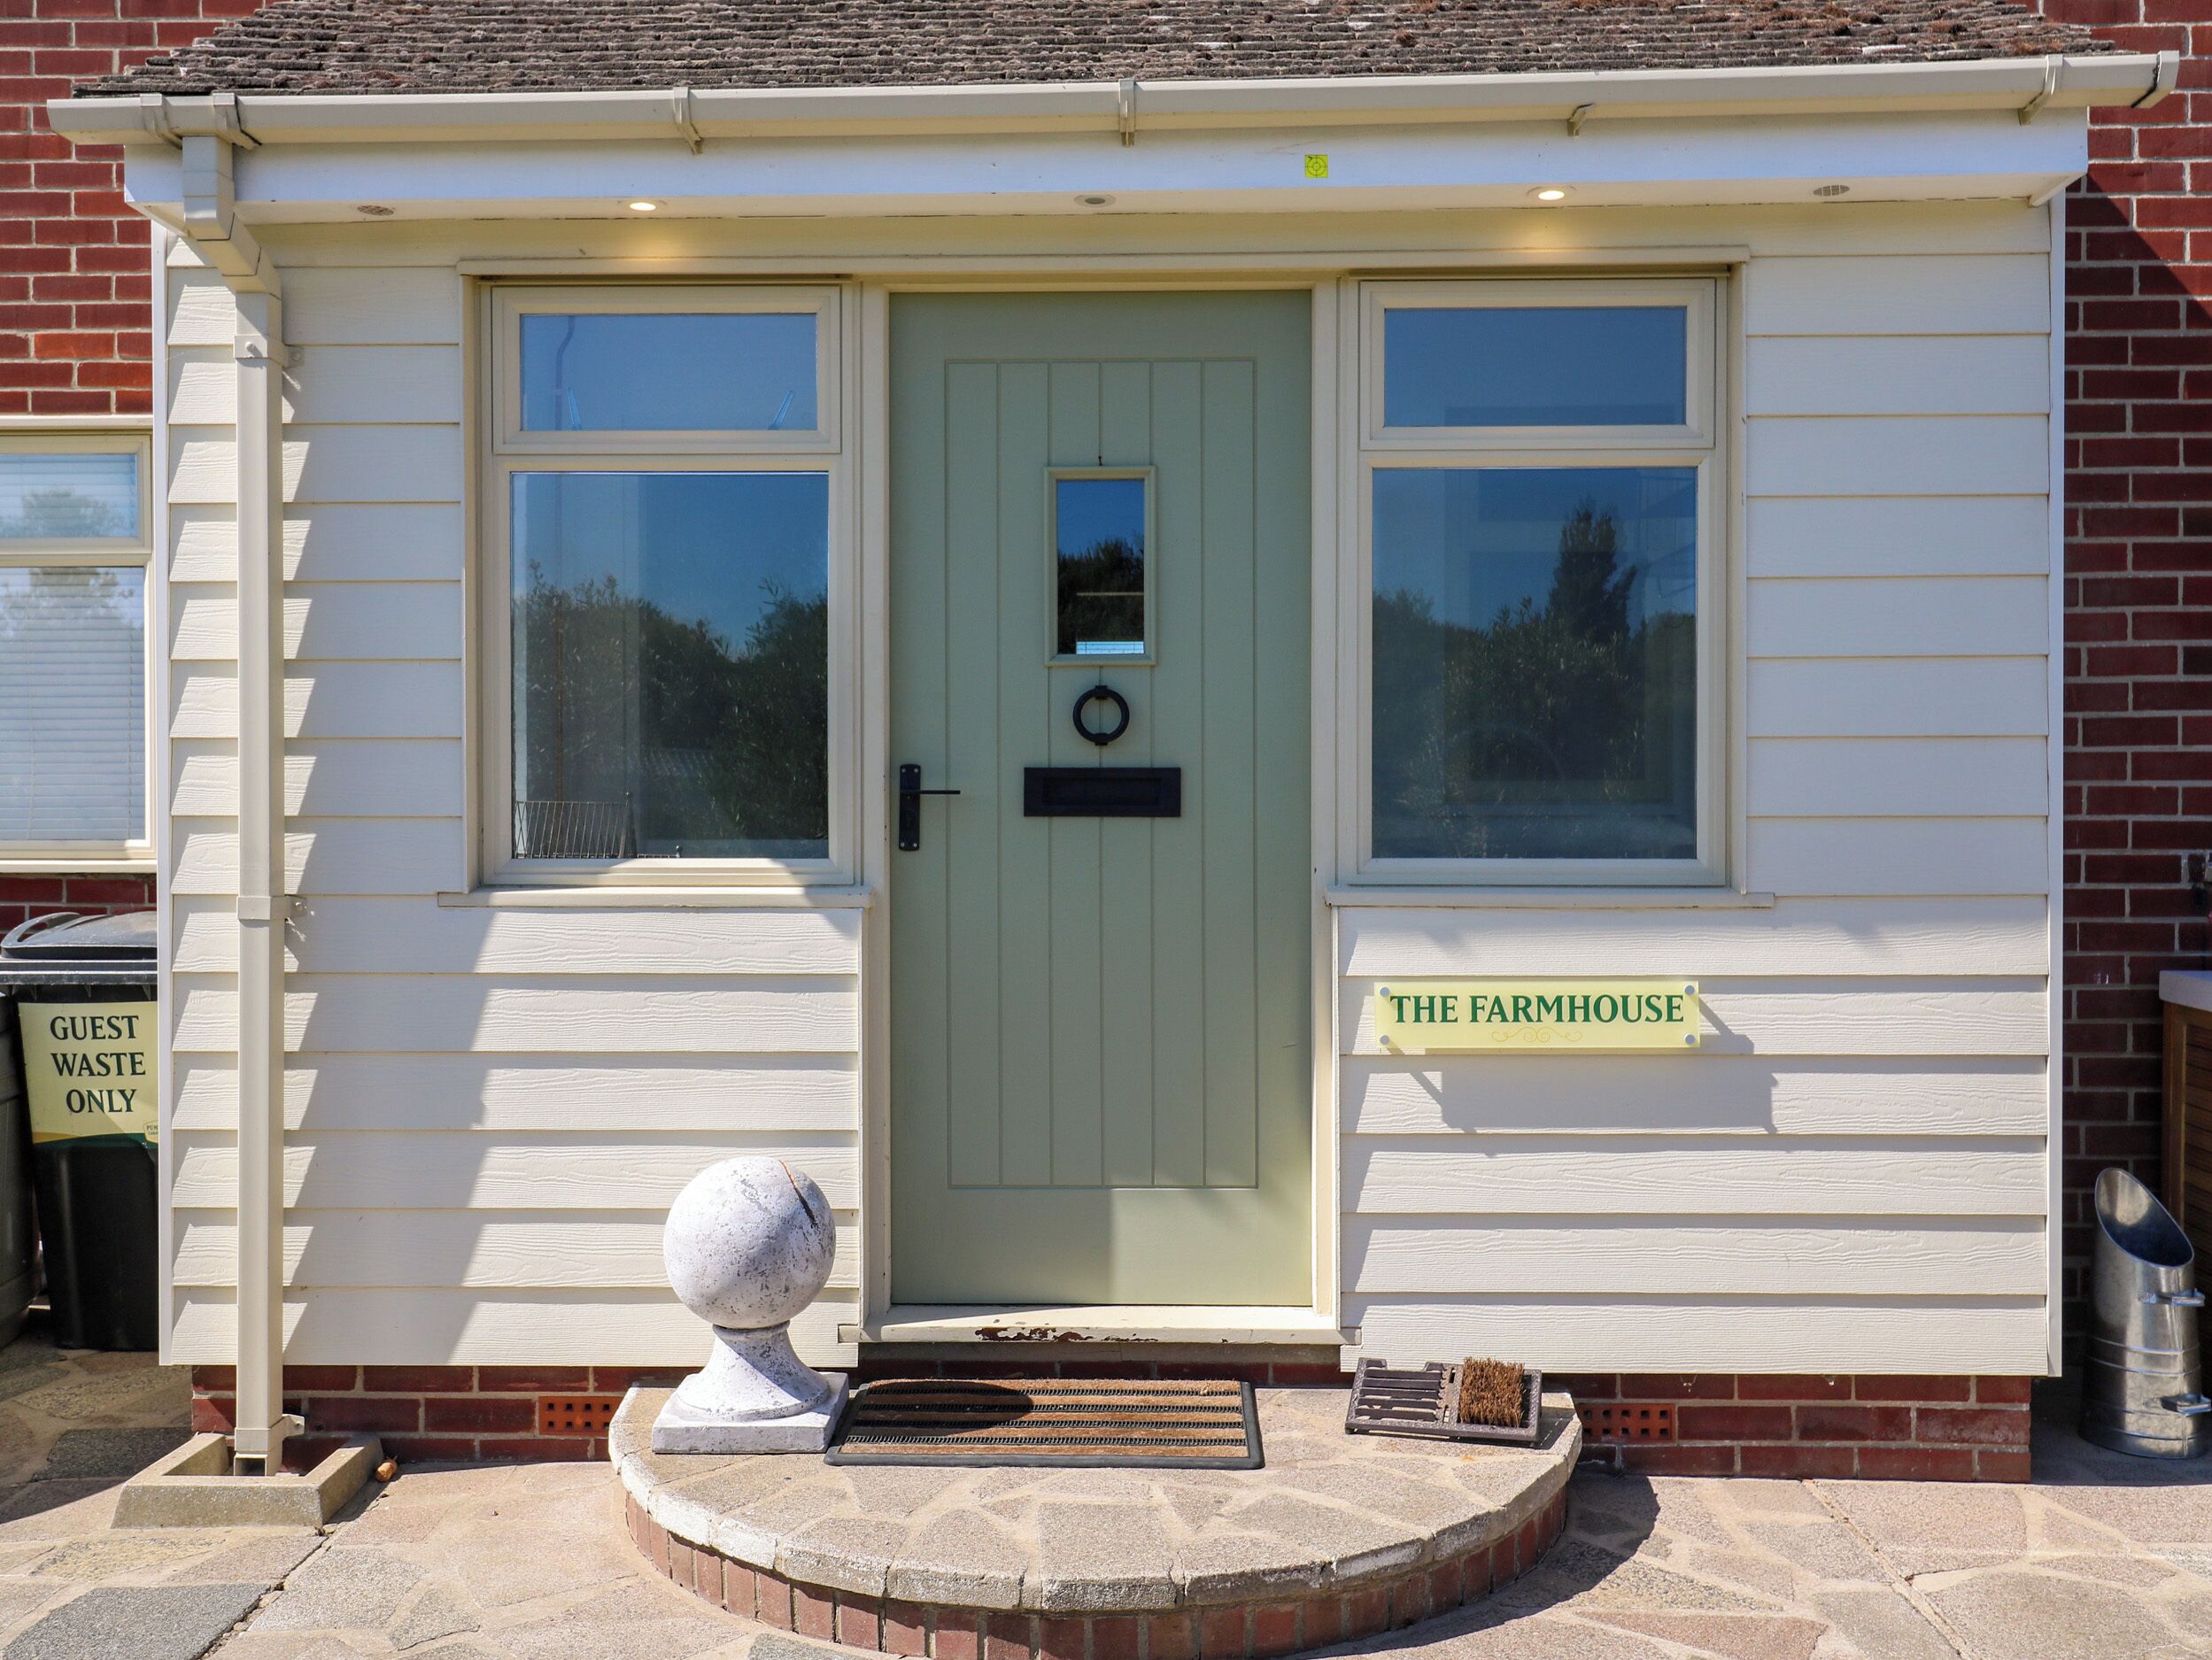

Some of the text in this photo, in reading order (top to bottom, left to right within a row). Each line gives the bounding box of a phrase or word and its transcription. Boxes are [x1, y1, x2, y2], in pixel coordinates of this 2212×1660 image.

[1389, 994, 1684, 1023] THE FARMHOUSE
[50, 1015, 140, 1041] GUEST
[50, 1052, 146, 1077] WASTE
[66, 1088, 137, 1115] ONLY
